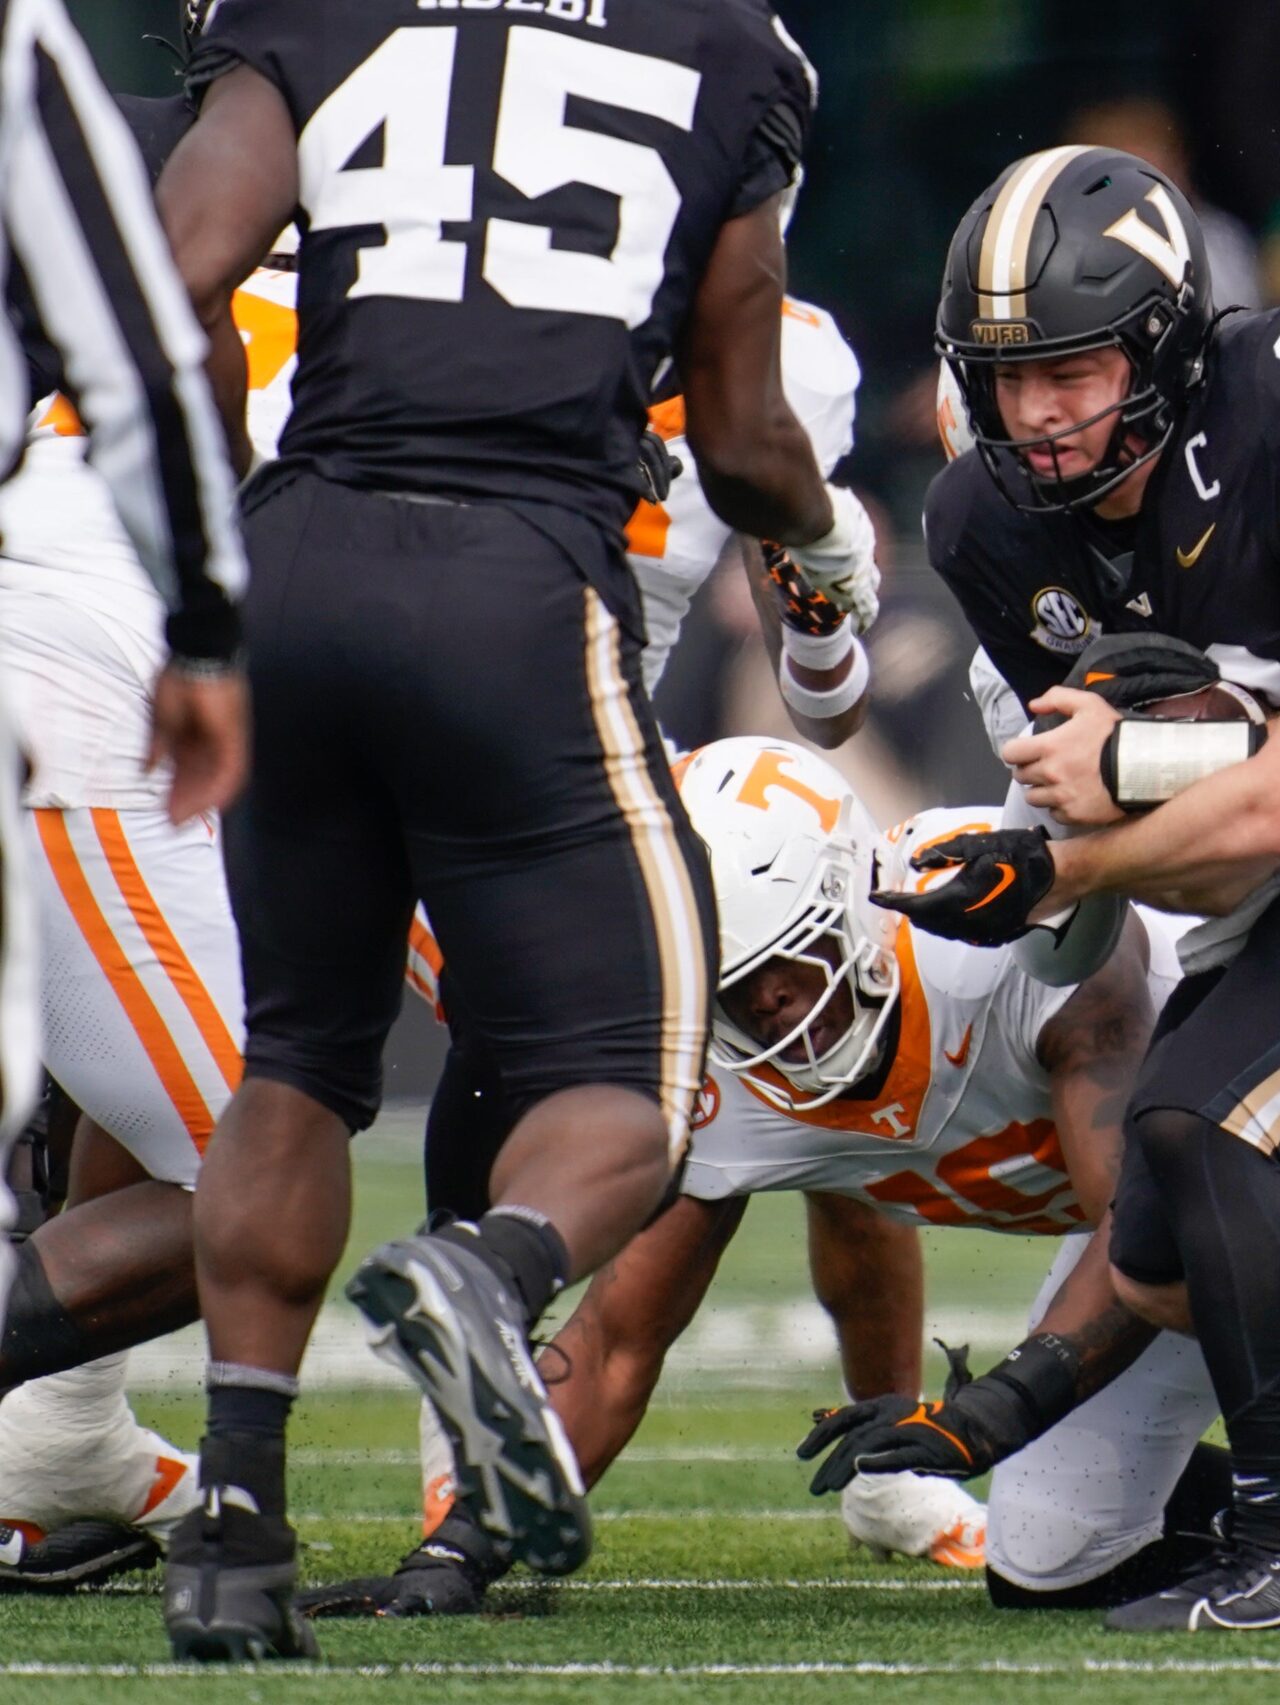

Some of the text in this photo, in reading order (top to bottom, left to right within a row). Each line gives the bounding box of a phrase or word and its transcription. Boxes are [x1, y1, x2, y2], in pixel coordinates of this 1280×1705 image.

[297, 25, 702, 331] 45
[1102, 185, 1191, 292] V
[1185, 431, 1220, 500] C
[1037, 591, 1085, 638] SEC
[736, 750, 841, 834] T
[870, 1102, 910, 1138] T
